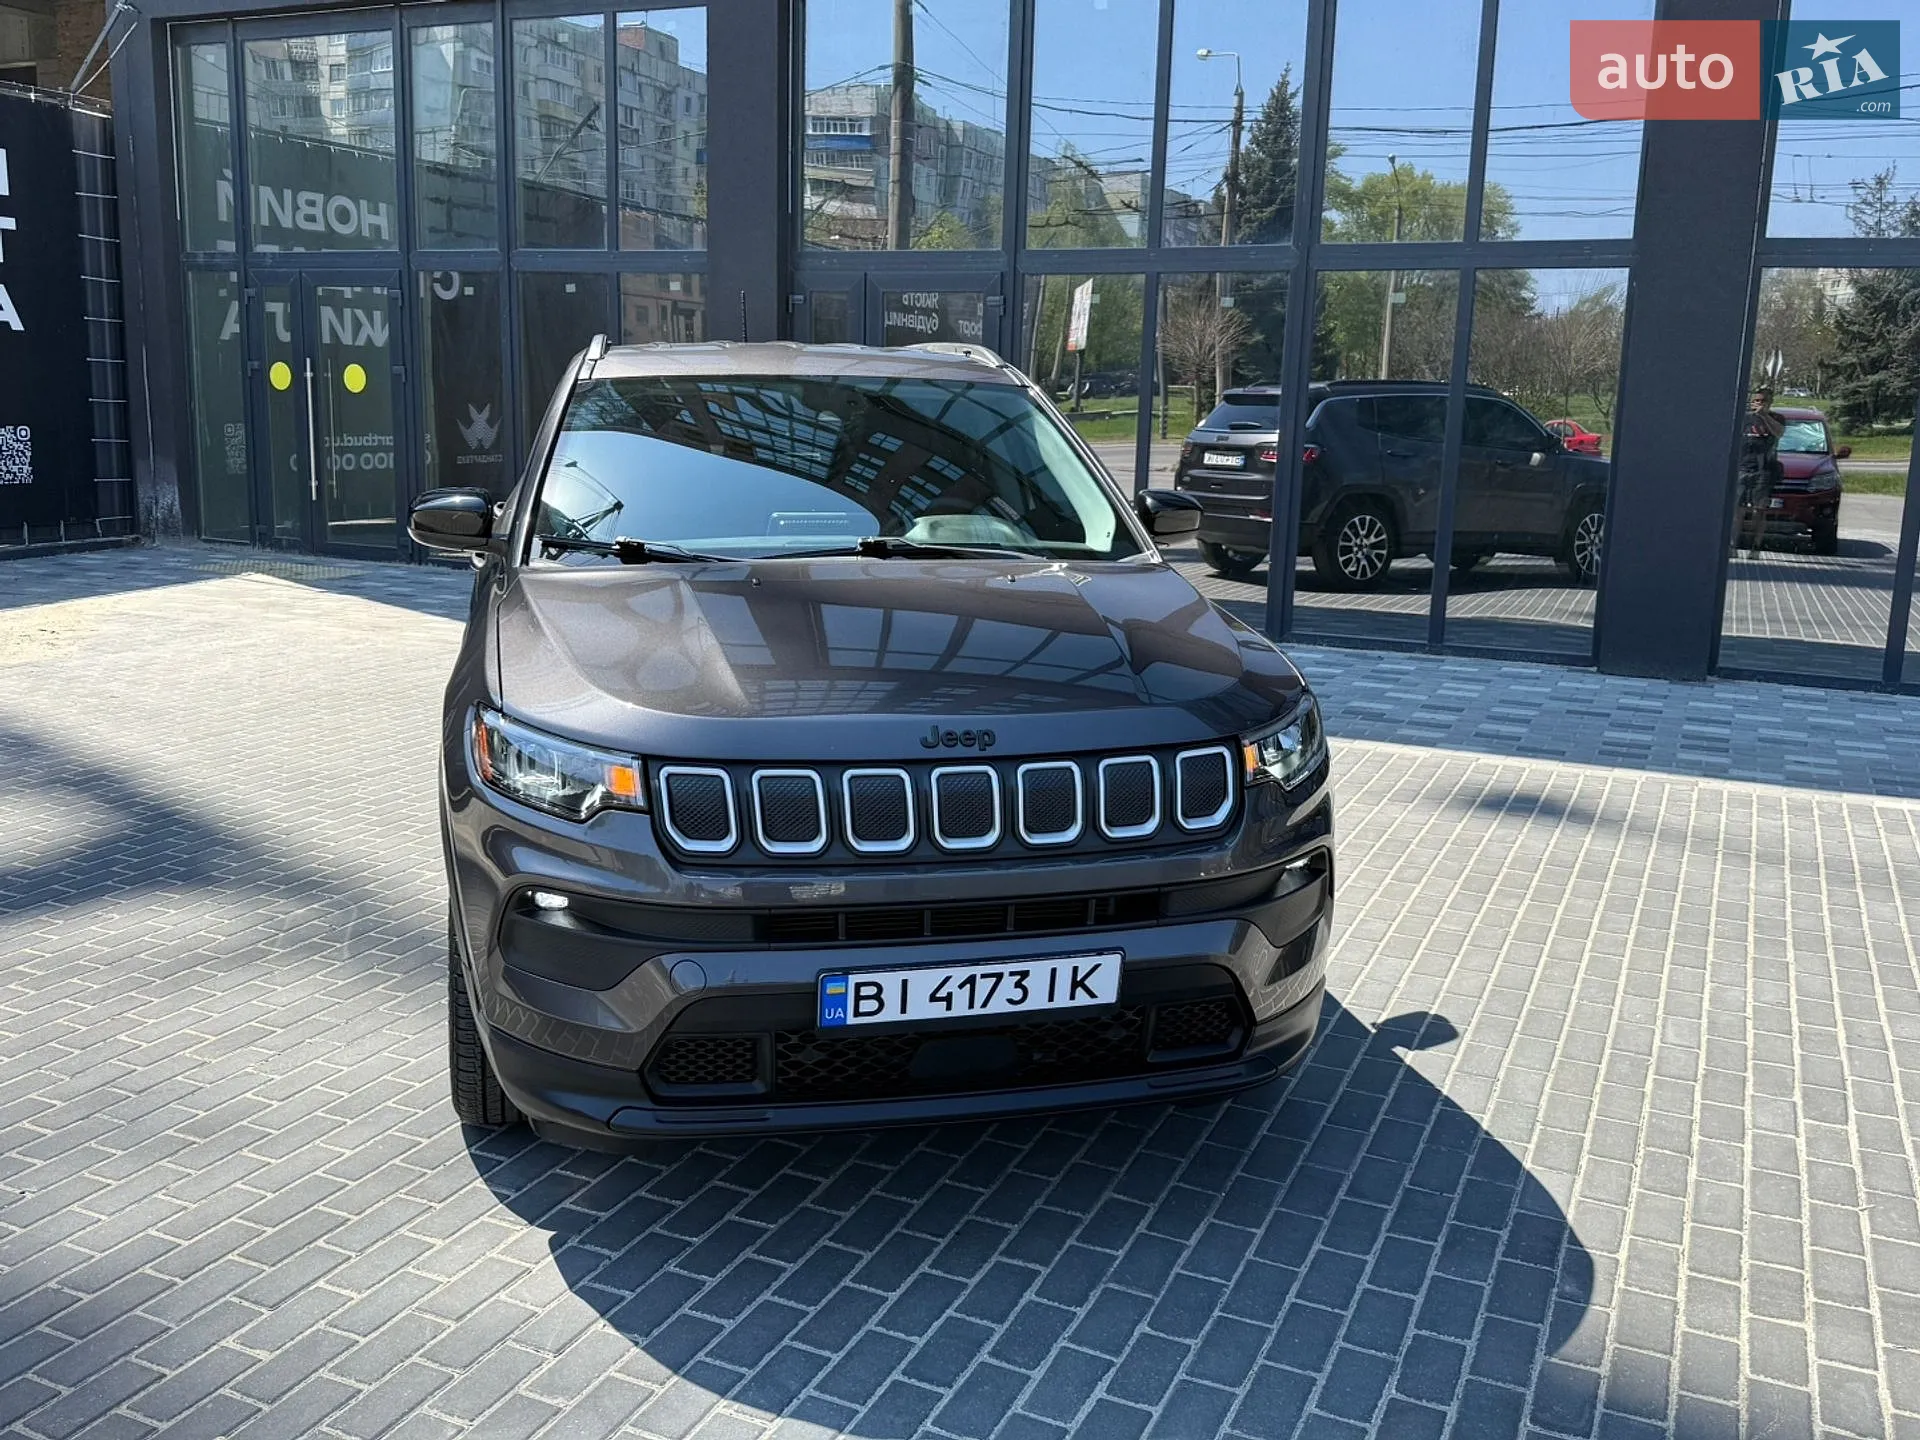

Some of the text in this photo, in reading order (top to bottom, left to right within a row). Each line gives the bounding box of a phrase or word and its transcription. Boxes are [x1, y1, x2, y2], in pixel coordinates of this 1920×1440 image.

[920, 724, 996, 752] Jeep
[928, 969, 1031, 1012] 4173
[825, 1007, 845, 1020] UA
